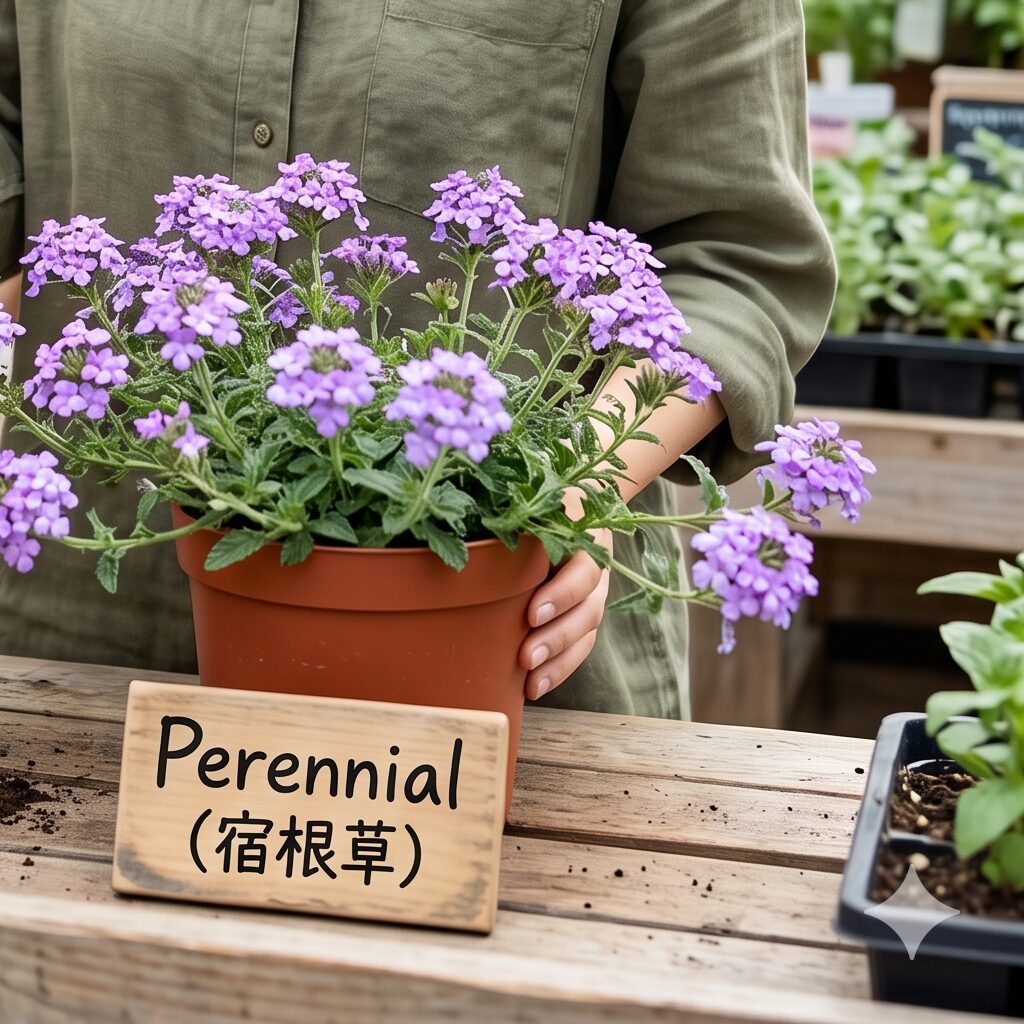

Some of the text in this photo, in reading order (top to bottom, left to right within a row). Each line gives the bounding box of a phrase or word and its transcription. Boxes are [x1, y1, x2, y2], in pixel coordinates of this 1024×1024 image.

[156, 715, 463, 810] Perennial
[189, 808, 422, 889] (宿根草)
